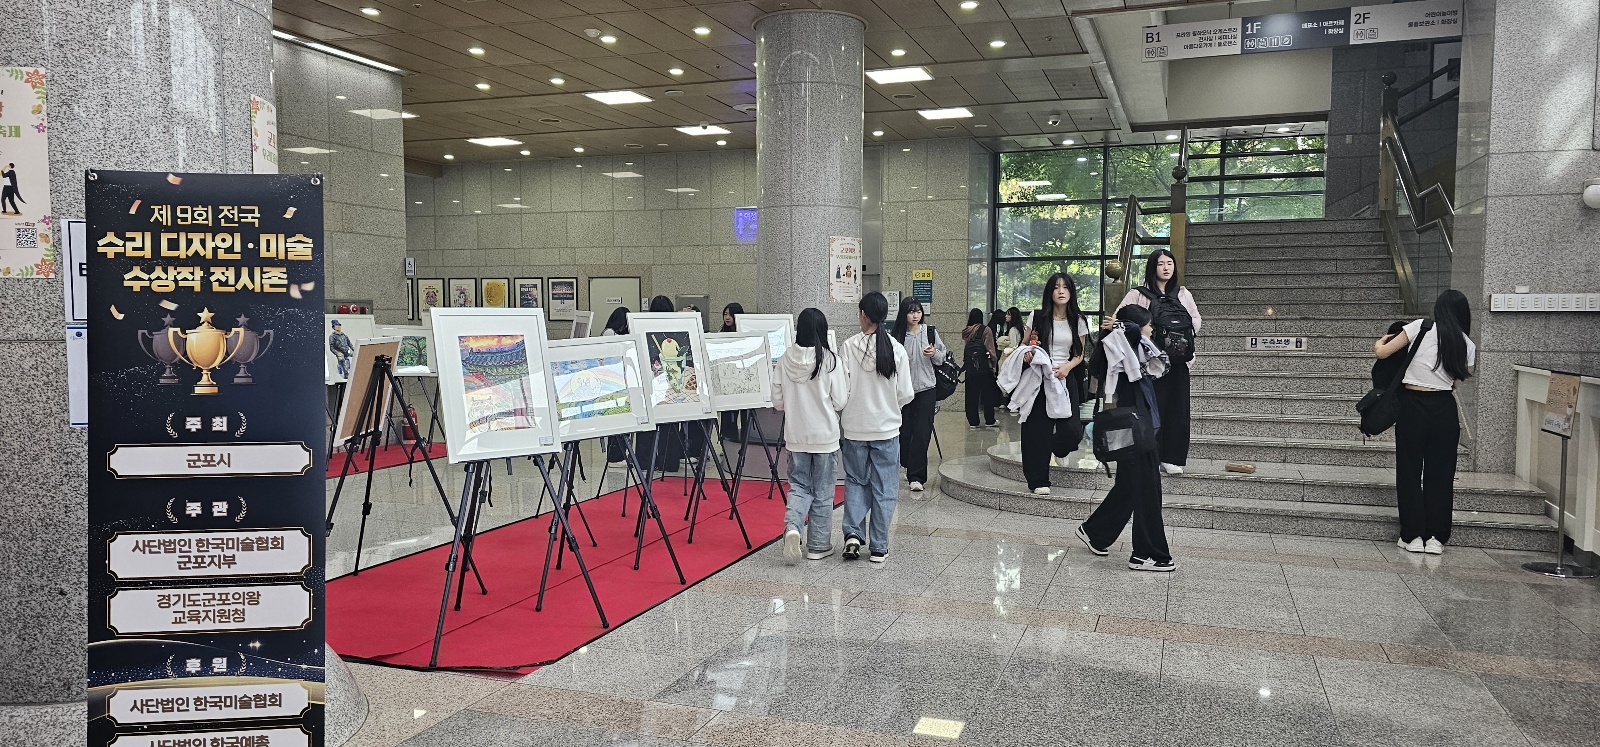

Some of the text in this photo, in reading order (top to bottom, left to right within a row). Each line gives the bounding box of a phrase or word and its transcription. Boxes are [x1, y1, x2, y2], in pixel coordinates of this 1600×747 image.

[1354, 12, 1371, 24] 2F
[1425, 10, 1458, 18] 어린이놀이방
[1213, 27, 1238, 35] 오케스트라
[1245, 22, 1261, 34] 1F
[1145, 31, 1161, 44] B1
[1183, 42, 1213, 50] 아름다운가게
[150, 204, 261, 228] 제 9회 전국
[97, 231, 152, 259] 수리
[123, 265, 288, 293] 수상작 전시존
[186, 453, 231, 469] 군포시
[131, 536, 285, 555] 사단법인 한국미술협회
[176, 554, 237, 571] 군포지부
[156, 591, 261, 609] 경기도군포의왕
[171, 608, 246, 625] 교육지원청
[129, 692, 283, 714] 사단법인 한국미술협회
